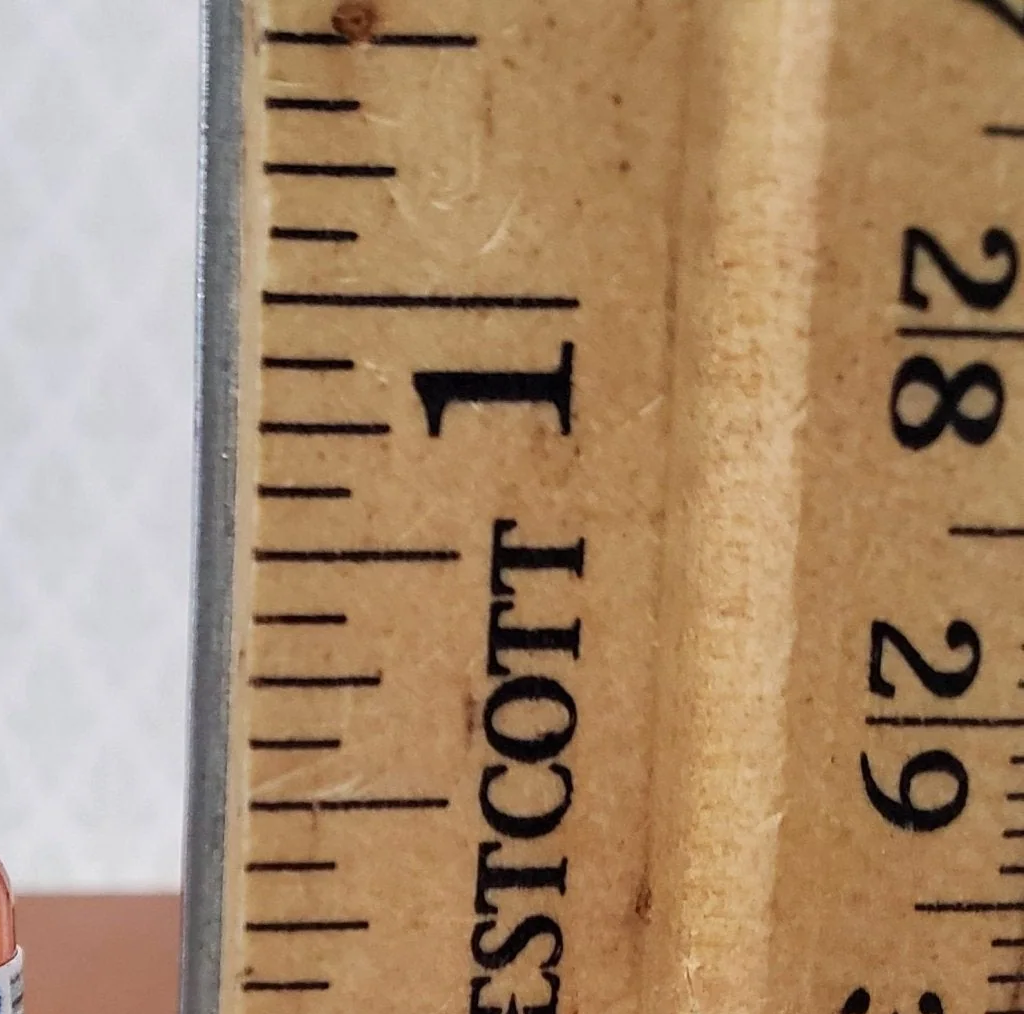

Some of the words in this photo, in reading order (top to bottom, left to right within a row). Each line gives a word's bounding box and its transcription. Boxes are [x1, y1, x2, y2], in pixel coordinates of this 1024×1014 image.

[413, 341, 574, 437] 1
[889, 227, 1021, 451] 28
[860, 620, 982, 833] 29
